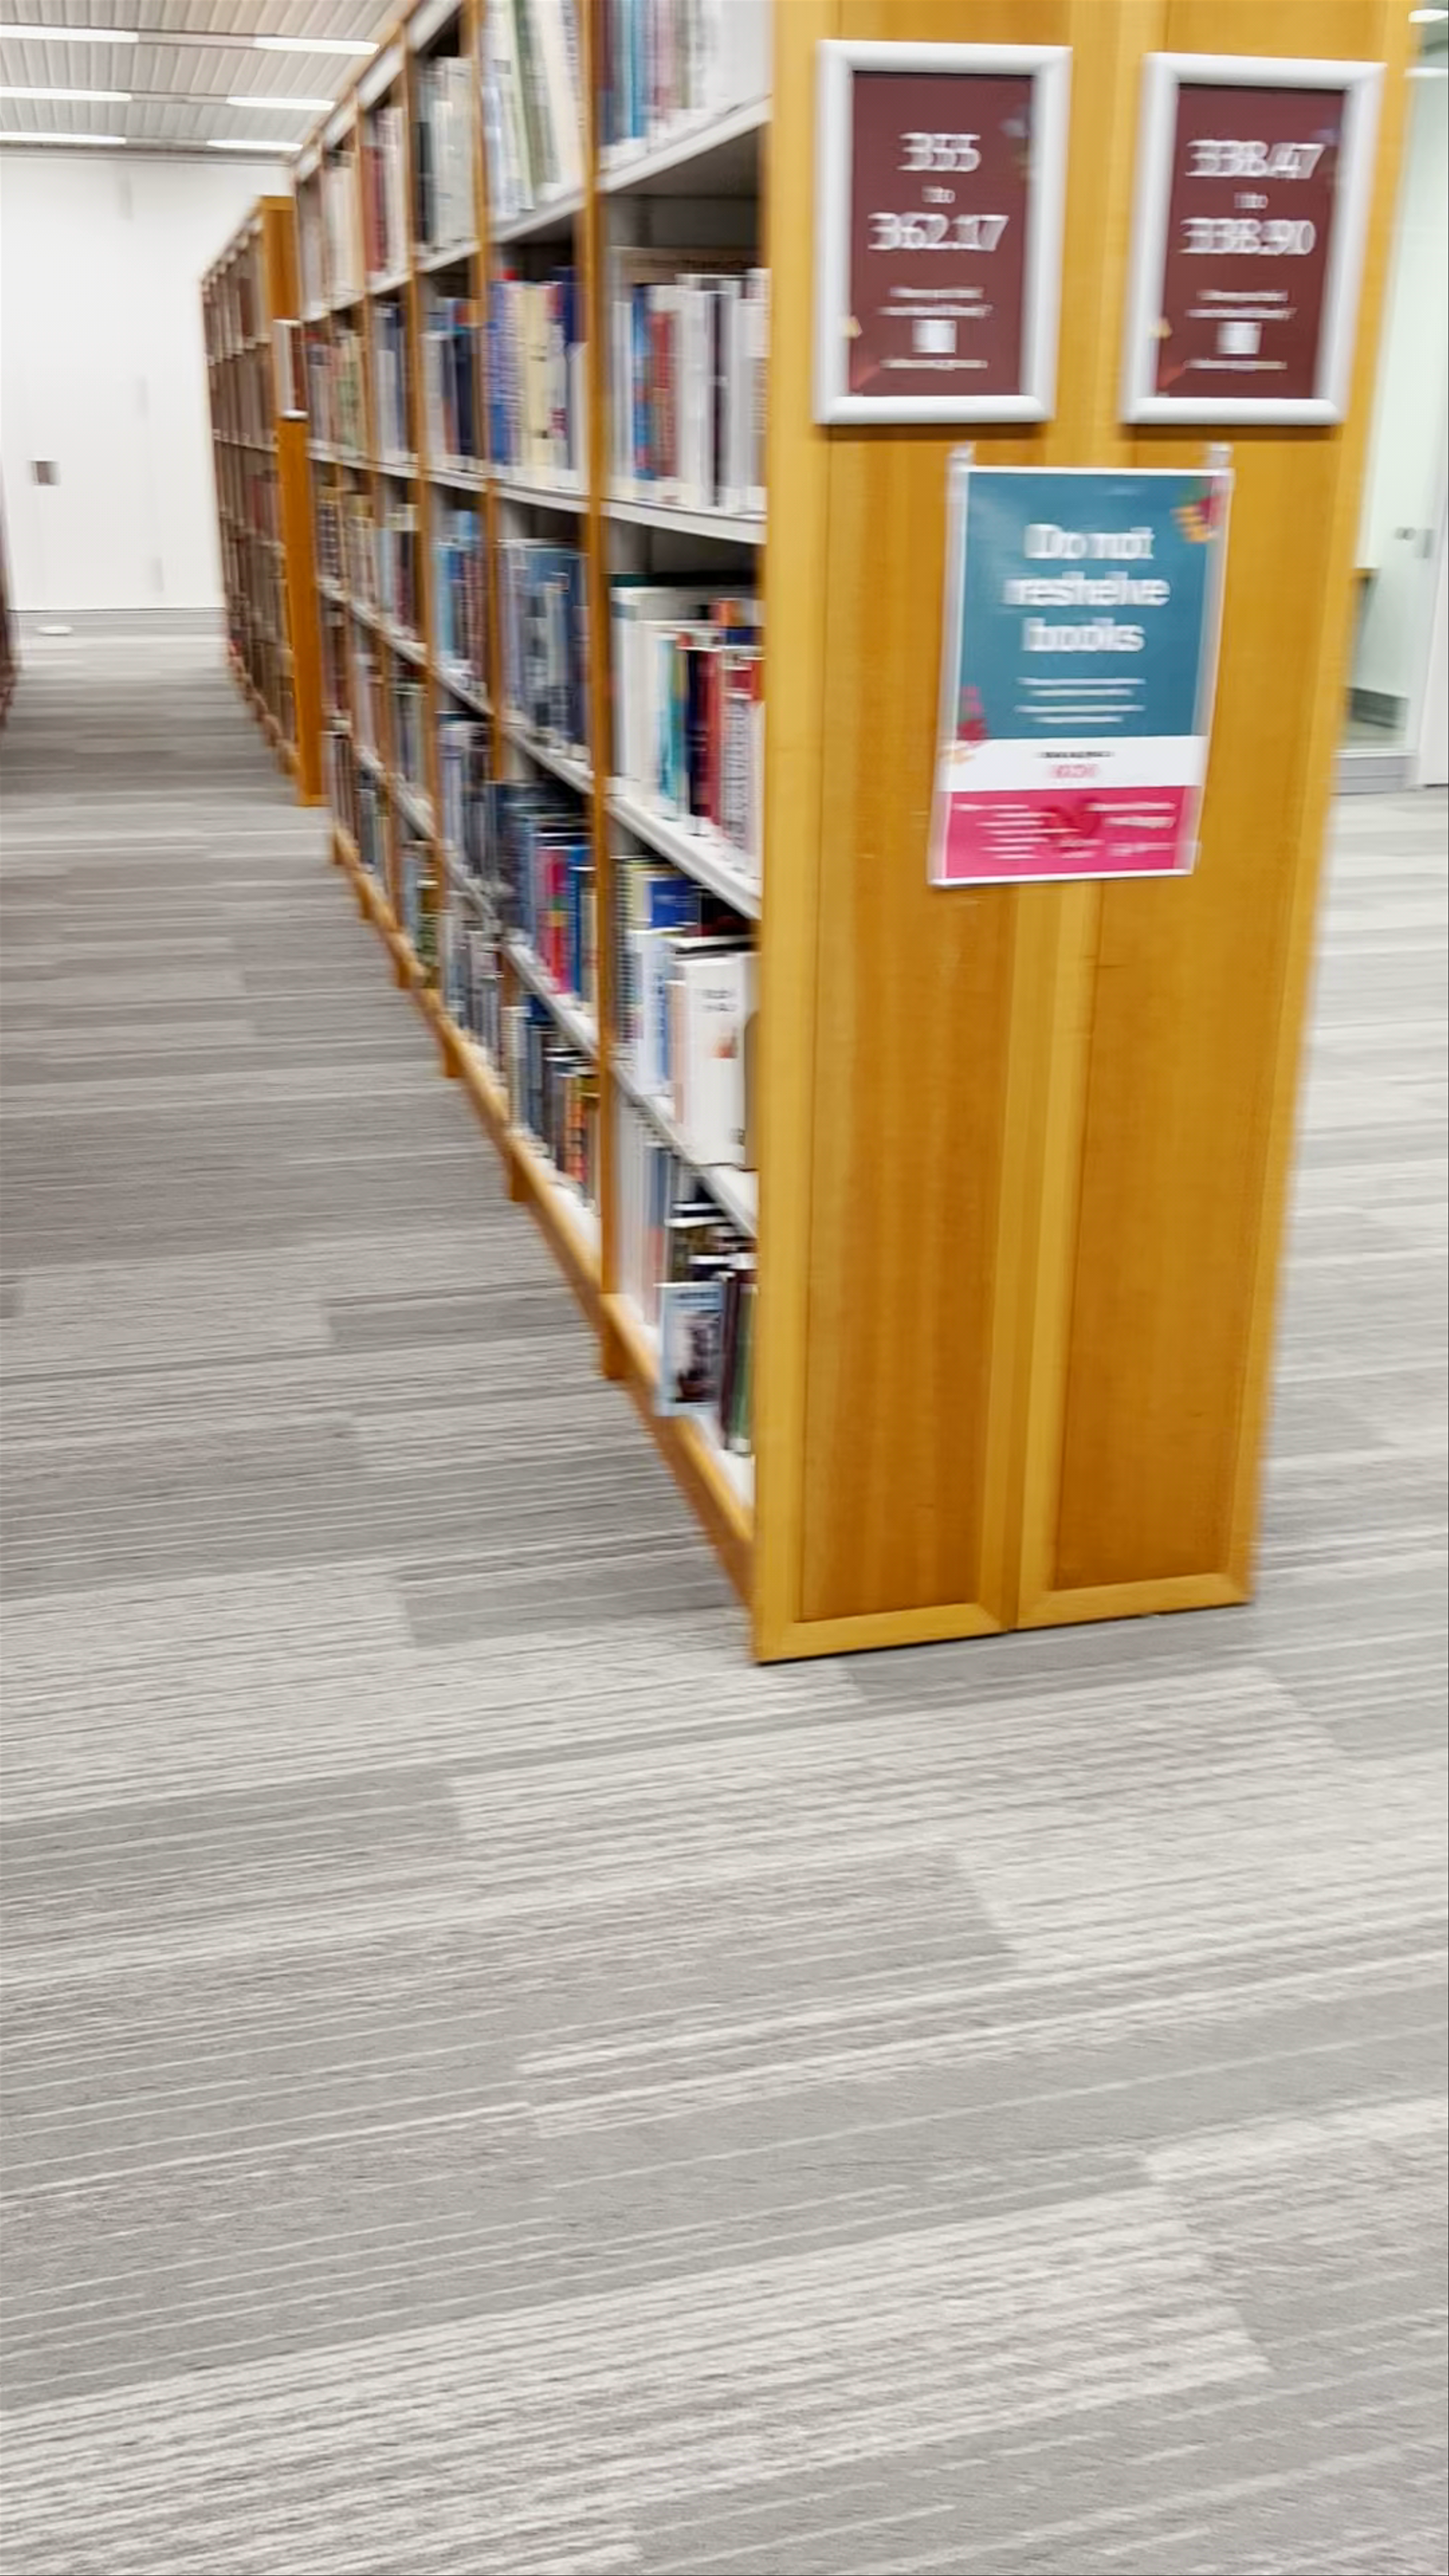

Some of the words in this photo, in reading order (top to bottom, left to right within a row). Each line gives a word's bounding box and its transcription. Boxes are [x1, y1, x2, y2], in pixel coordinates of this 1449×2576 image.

[897, 132, 981, 171] 355
[1024, 523, 1088, 559] Do
[1090, 526, 1155, 560] not
[1003, 571, 1171, 606] reshelve
[1022, 617, 1145, 652] books
